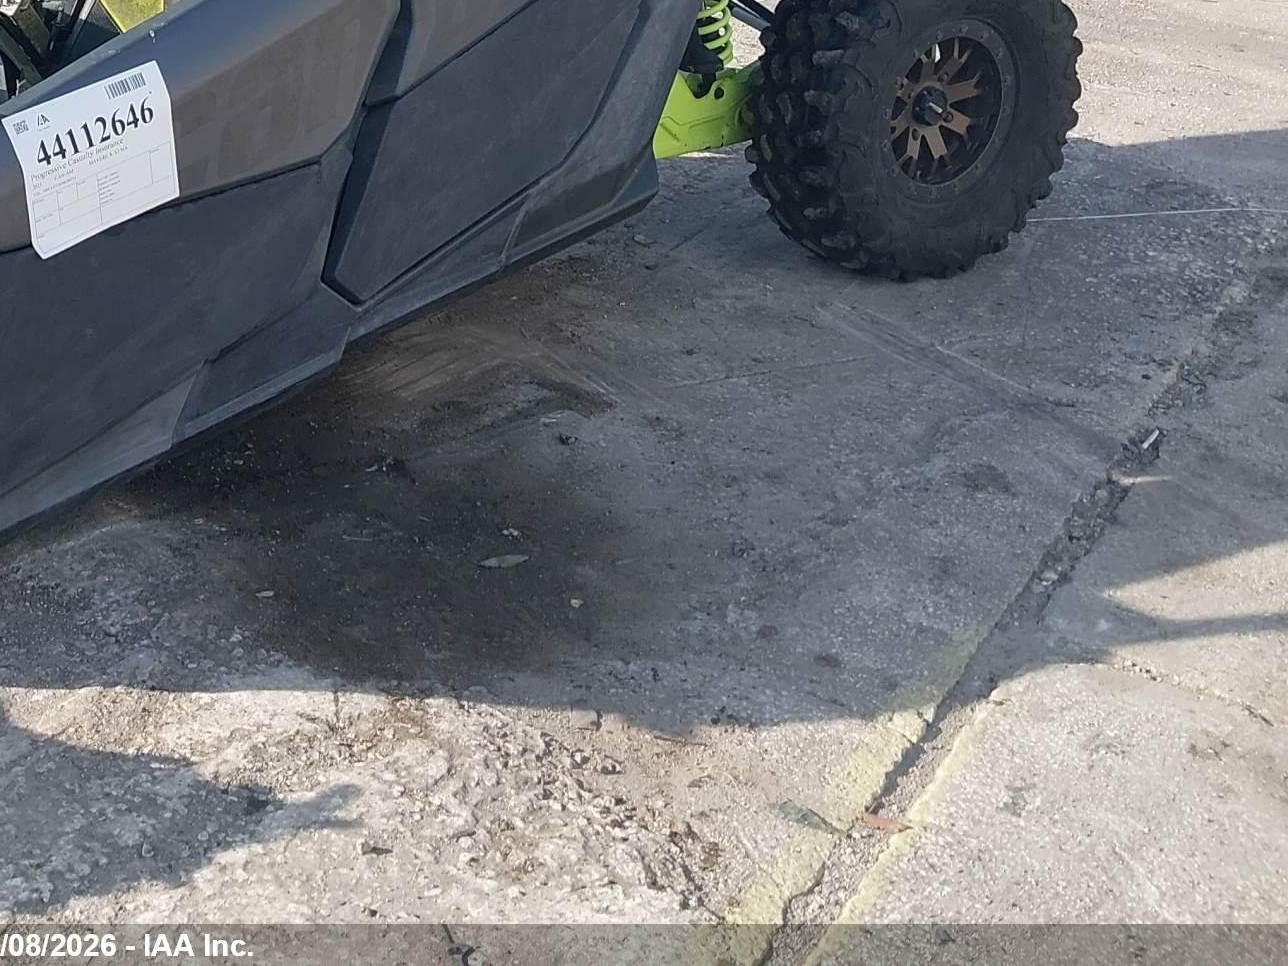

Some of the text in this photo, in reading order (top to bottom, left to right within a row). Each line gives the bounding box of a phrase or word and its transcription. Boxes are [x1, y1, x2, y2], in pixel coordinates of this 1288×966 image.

[37, 96, 153, 165] 44112646
[31, 162, 67, 182] Progressive
[68, 151, 93, 167] Casualty
[95, 139, 124, 154] Insurance
